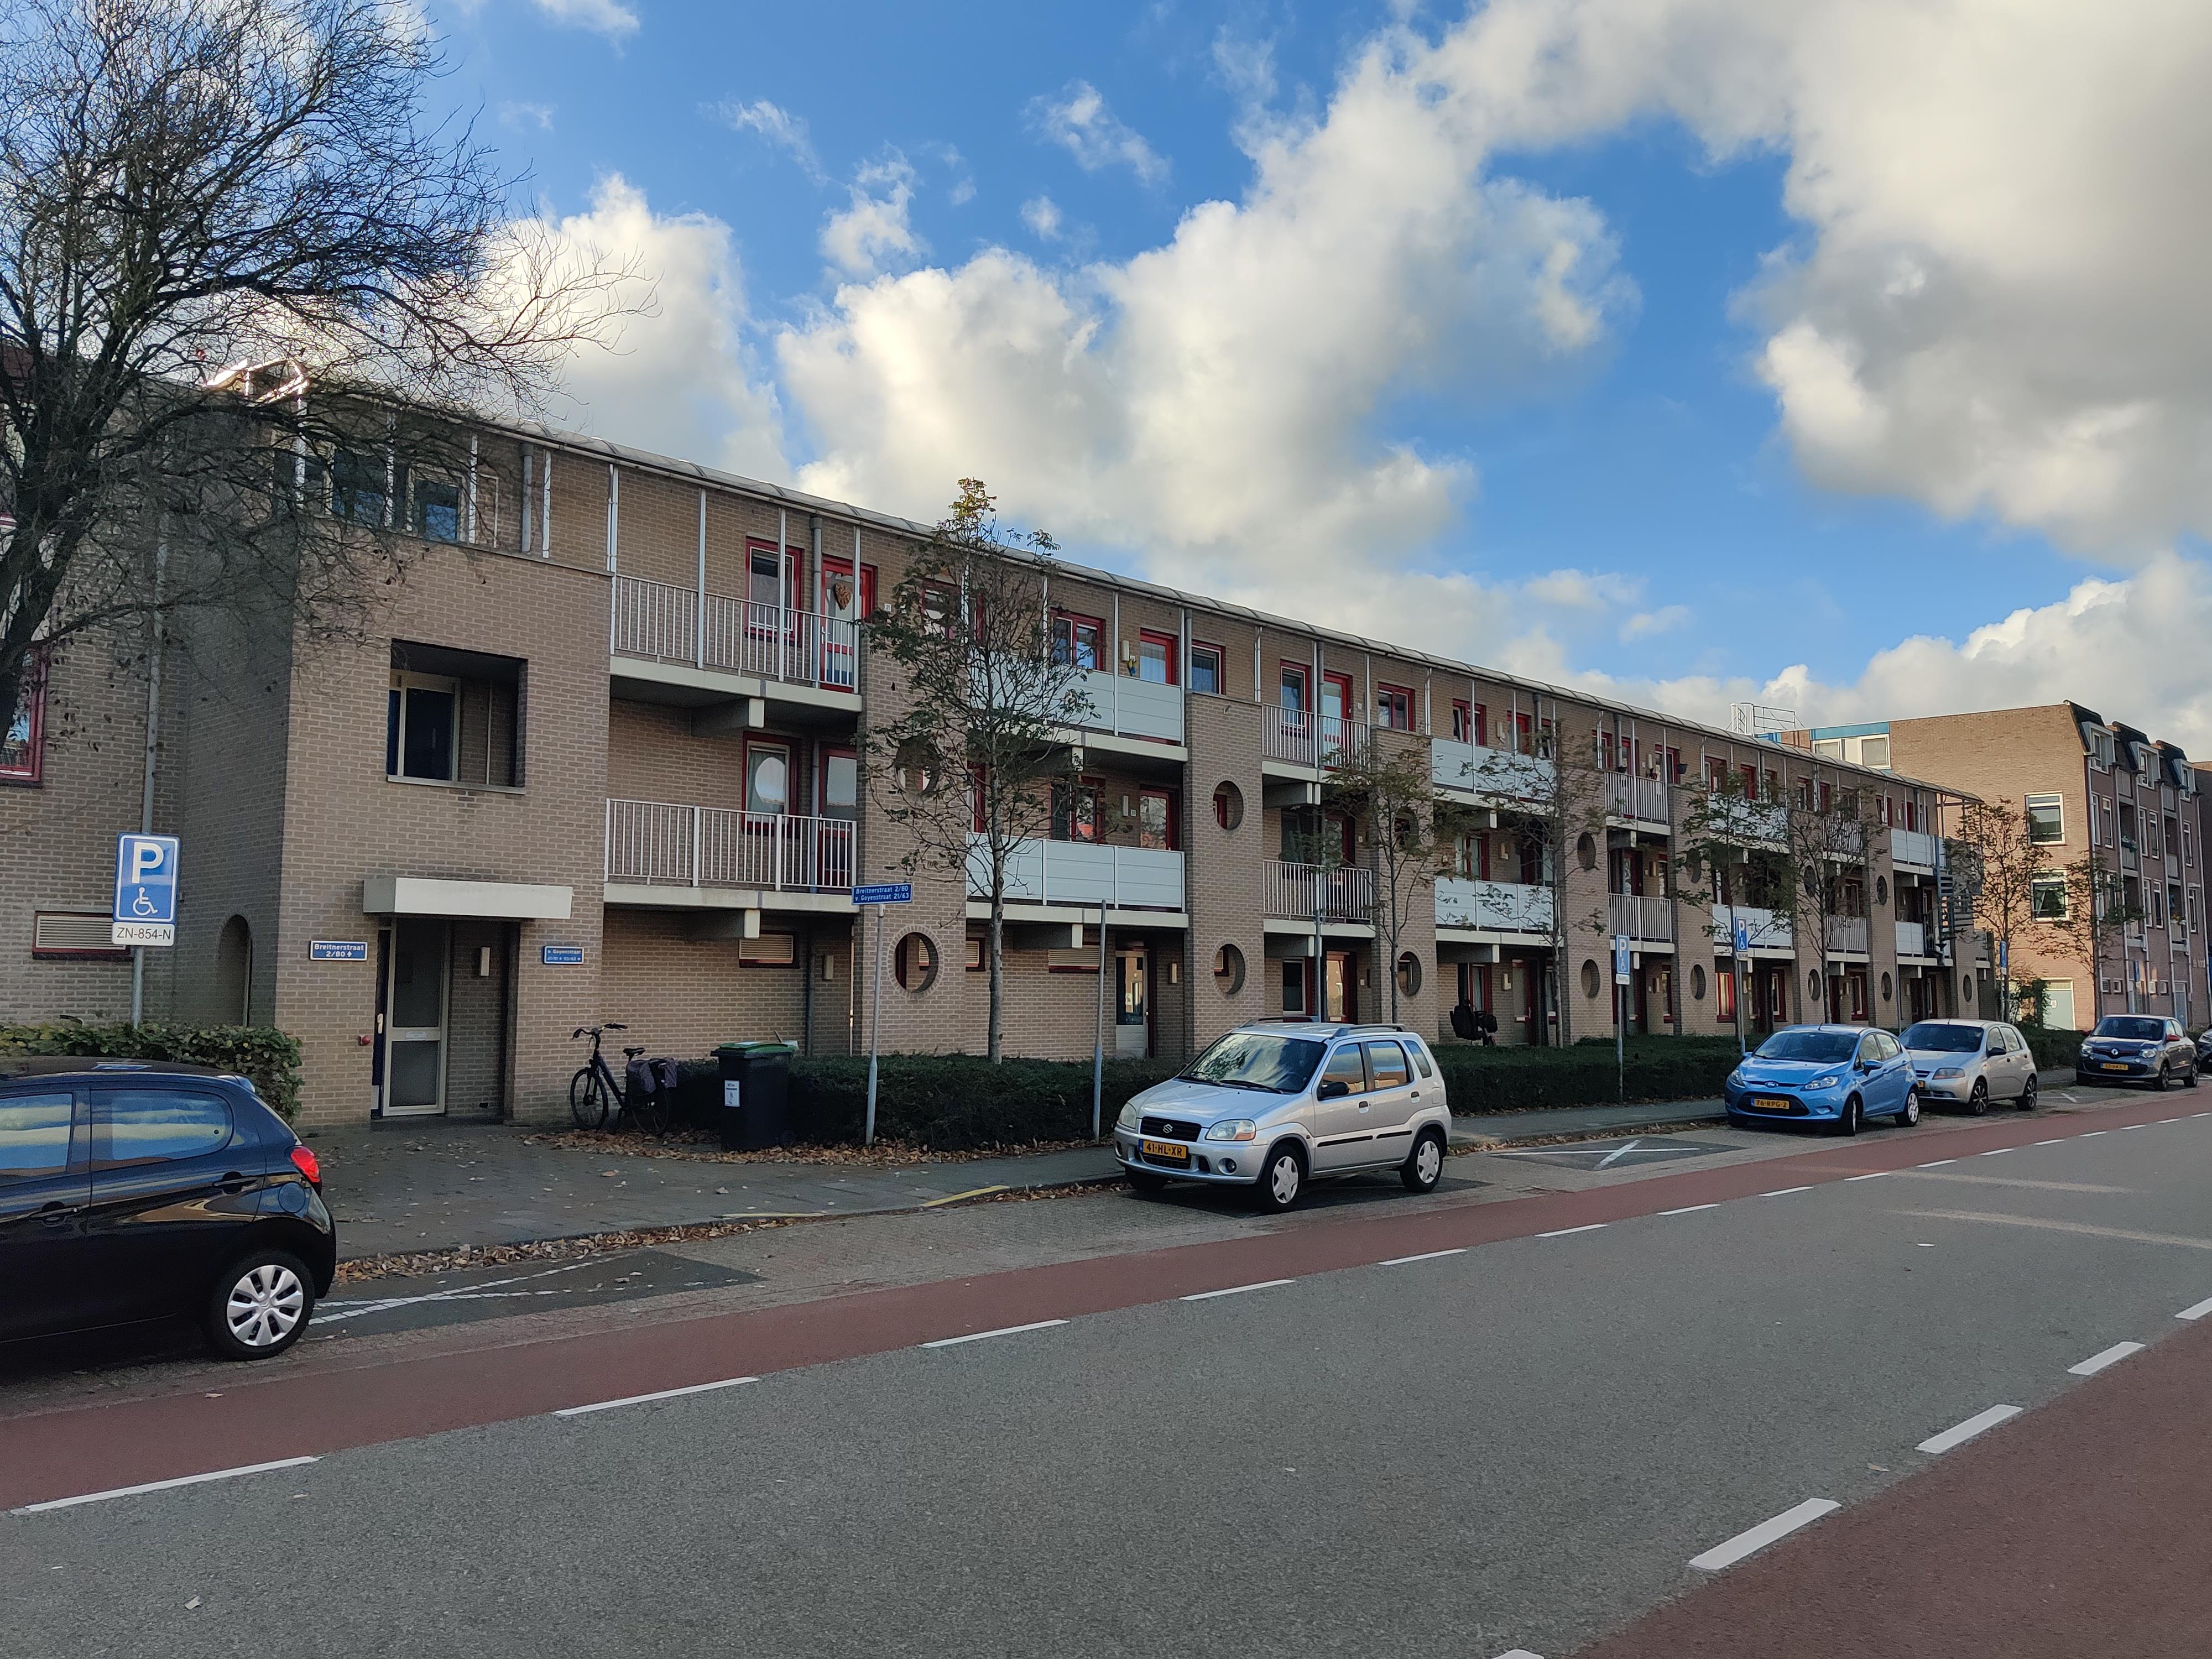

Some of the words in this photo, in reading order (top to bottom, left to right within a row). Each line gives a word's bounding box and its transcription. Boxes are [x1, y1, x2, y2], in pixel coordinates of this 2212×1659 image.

[132, 842, 164, 884] P
[117, 927, 171, 940] ZN-854-N
[1738, 920, 1745, 937] P
[1619, 938, 1626, 958] P
[1146, 1142, 1182, 1157] 41-HL-XR
